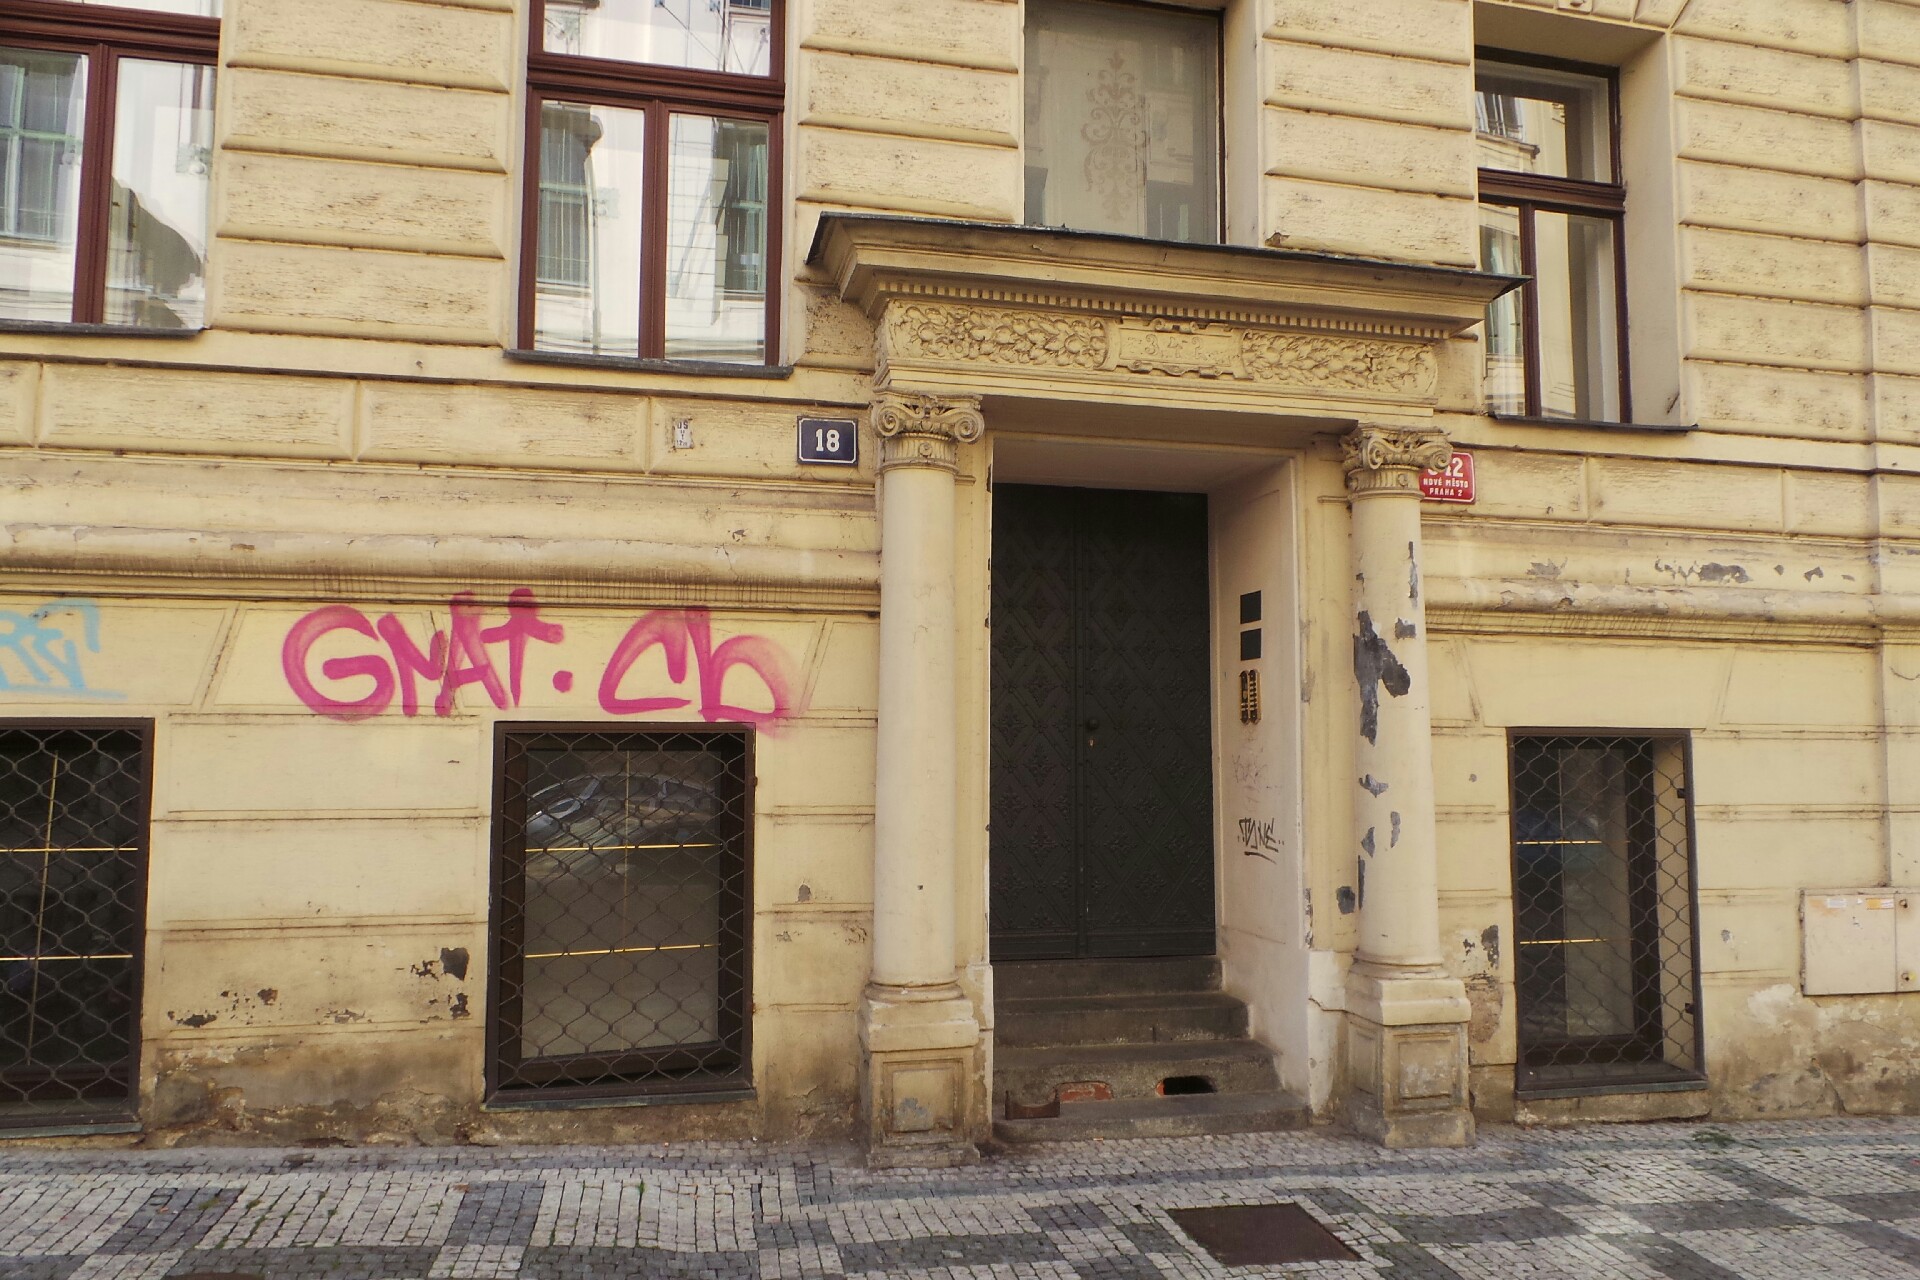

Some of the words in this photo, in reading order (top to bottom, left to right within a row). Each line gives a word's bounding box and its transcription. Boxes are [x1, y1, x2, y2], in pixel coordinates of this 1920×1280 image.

[815, 428, 840, 452] 18
[1423, 477, 1443, 486] NOVÉ
[1445, 477, 1469, 489] MĚSTO
[1429, 487, 1455, 496] PRAHA
[1457, 489, 1463, 497] 2
